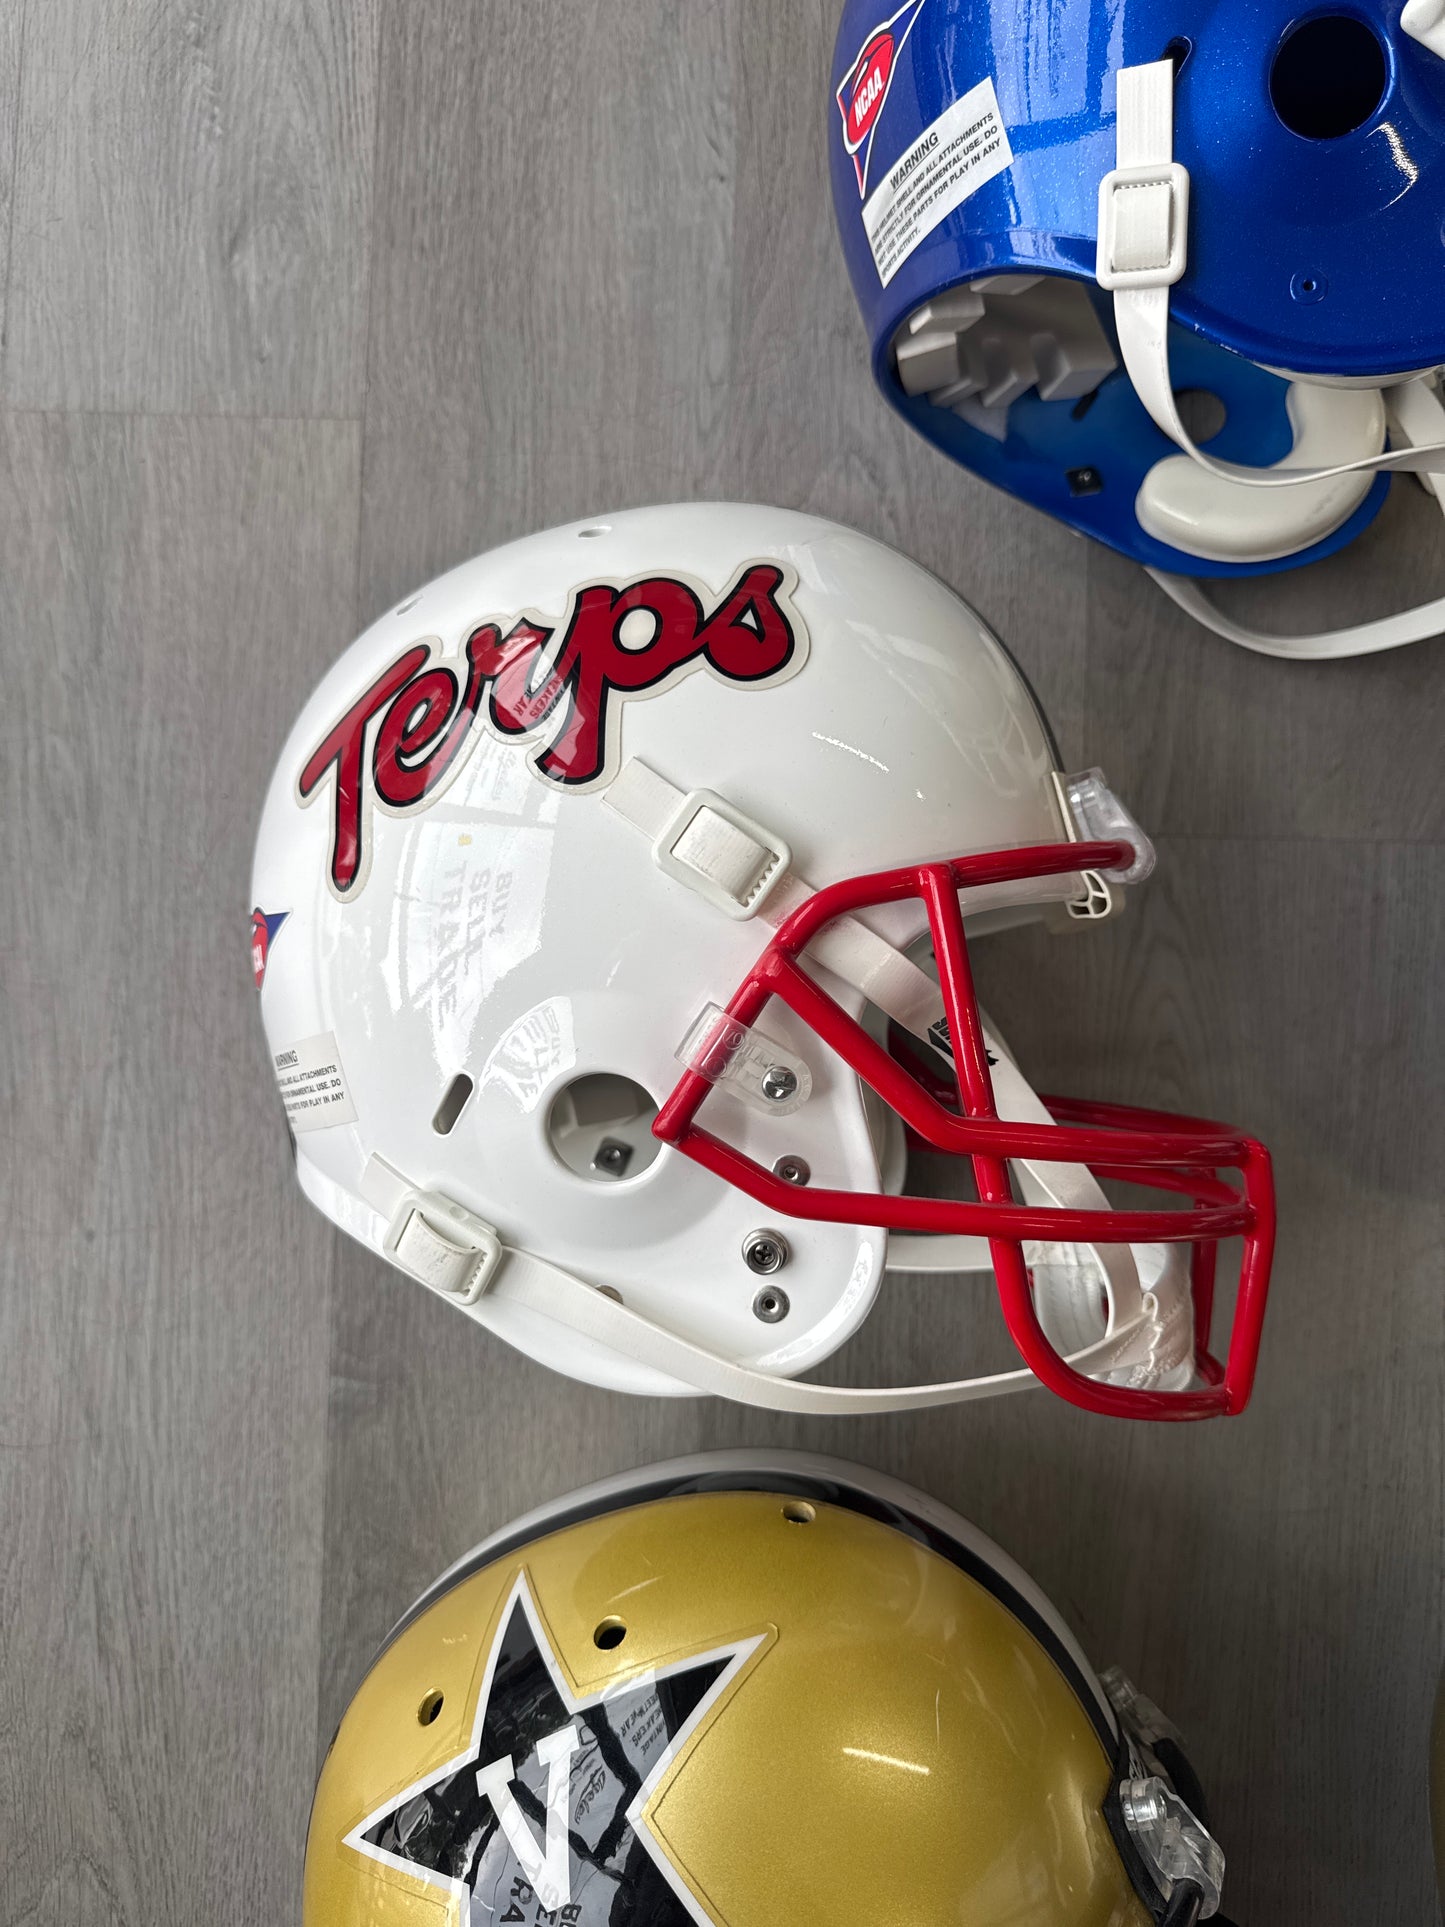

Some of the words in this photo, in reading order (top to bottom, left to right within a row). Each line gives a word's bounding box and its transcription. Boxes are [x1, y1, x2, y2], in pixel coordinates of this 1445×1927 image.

[854, 66, 885, 127] NCAA
[882, 211, 903, 243] STRICTLY
[904, 198, 916, 215] FOR
[916, 154, 962, 200] ORNAMENTAL
[963, 138, 983, 156] USE.
[984, 125, 998, 140] DO
[890, 132, 939, 190] WARNING
[895, 217, 913, 241] THESE
[913, 195, 934, 221] PARTS
[933, 181, 949, 199] FOR
[949, 161, 969, 184] PLAY
[970, 153, 981, 166] IN
[983, 138, 1000, 157] ANY
[896, 187, 913, 208] SHELL
[912, 172, 925, 190] AND
[925, 160, 938, 176] ALL
[938, 112, 994, 163] ATTACHMENTS
[299, 564, 795, 892] Terps
[300, 1064, 338, 1080] ATTACHMENTS
[308, 1097, 322, 1107] PLAY
[322, 1095, 331, 1104] IN
[331, 1091, 345, 1102] ANY
[330, 1078, 342, 1088] DO
[476, 1725, 580, 1913] V
